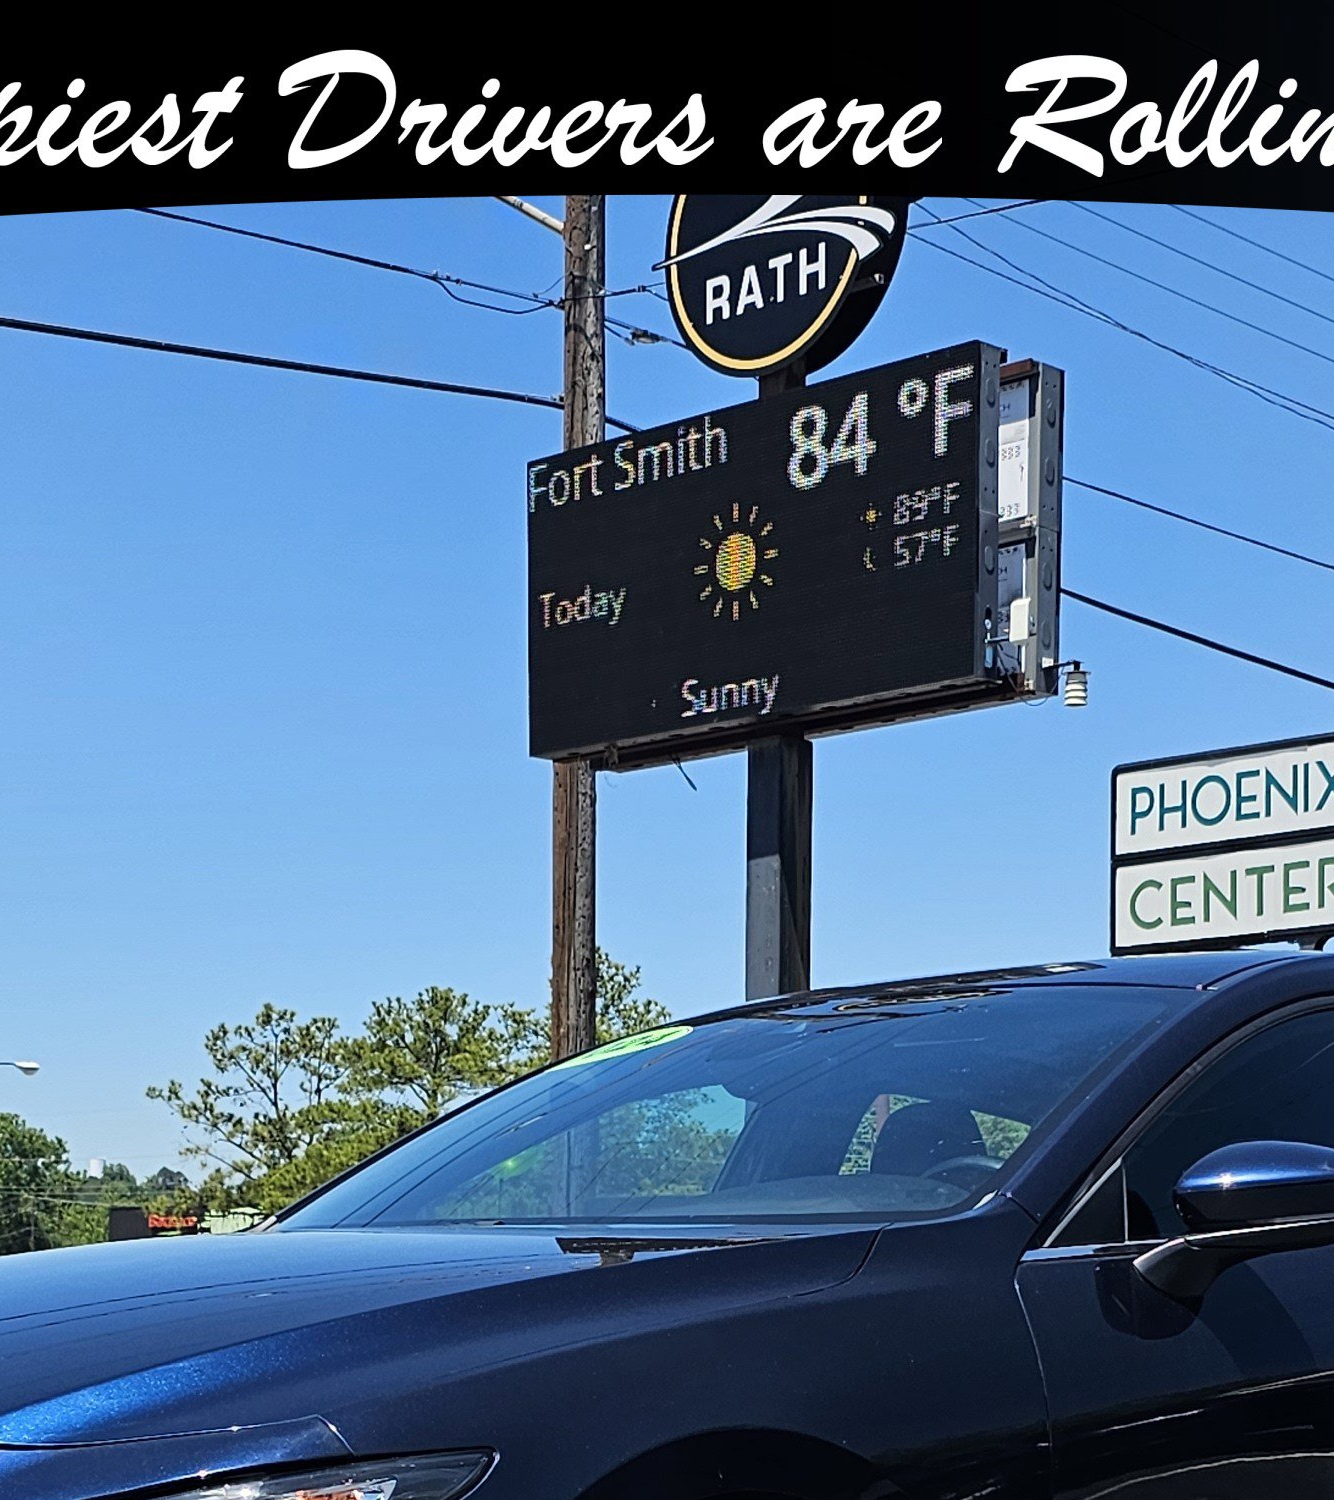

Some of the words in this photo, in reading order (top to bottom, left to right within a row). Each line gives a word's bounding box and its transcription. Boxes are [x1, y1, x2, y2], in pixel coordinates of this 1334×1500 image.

[704, 242, 828, 325] RATH
[528, 453, 603, 513] Fort
[614, 416, 728, 491] Smith
[787, 391, 876, 490] 84
[539, 584, 627, 628] Today
[681, 674, 780, 718] Sunny
